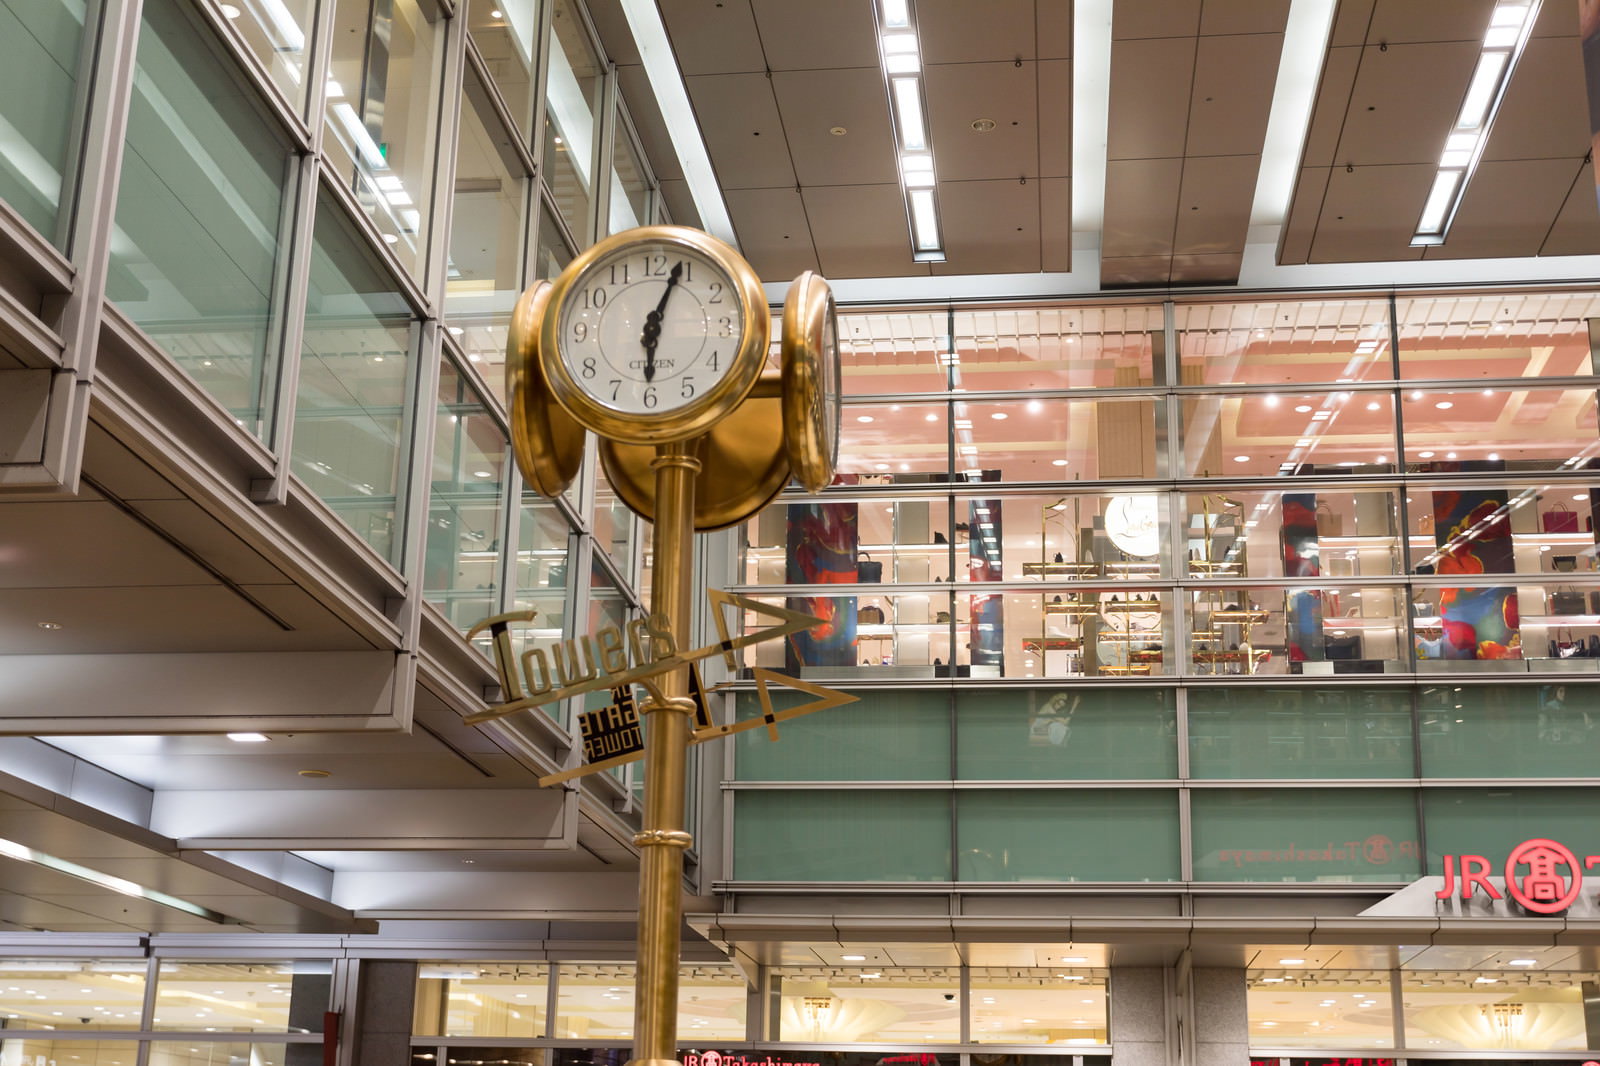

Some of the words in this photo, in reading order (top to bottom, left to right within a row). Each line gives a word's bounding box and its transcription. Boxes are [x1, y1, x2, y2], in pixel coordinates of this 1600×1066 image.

[609, 264, 630, 285] 11
[643, 256, 667, 277] 12
[685, 261, 693, 282] 1
[584, 287, 607, 309] 10
[708, 282, 723, 304] 2
[574, 322, 588, 343] 9
[718, 317, 732, 339] 3
[582, 357, 596, 379] 8
[629, 359, 674, 369] CITZEN
[706, 351, 720, 372] 4
[609, 380, 622, 401] 7
[643, 387, 657, 408] 6
[681, 376, 695, 399] 5
[466, 610, 677, 702] Towers
[1435, 855, 1503, 899] JR
